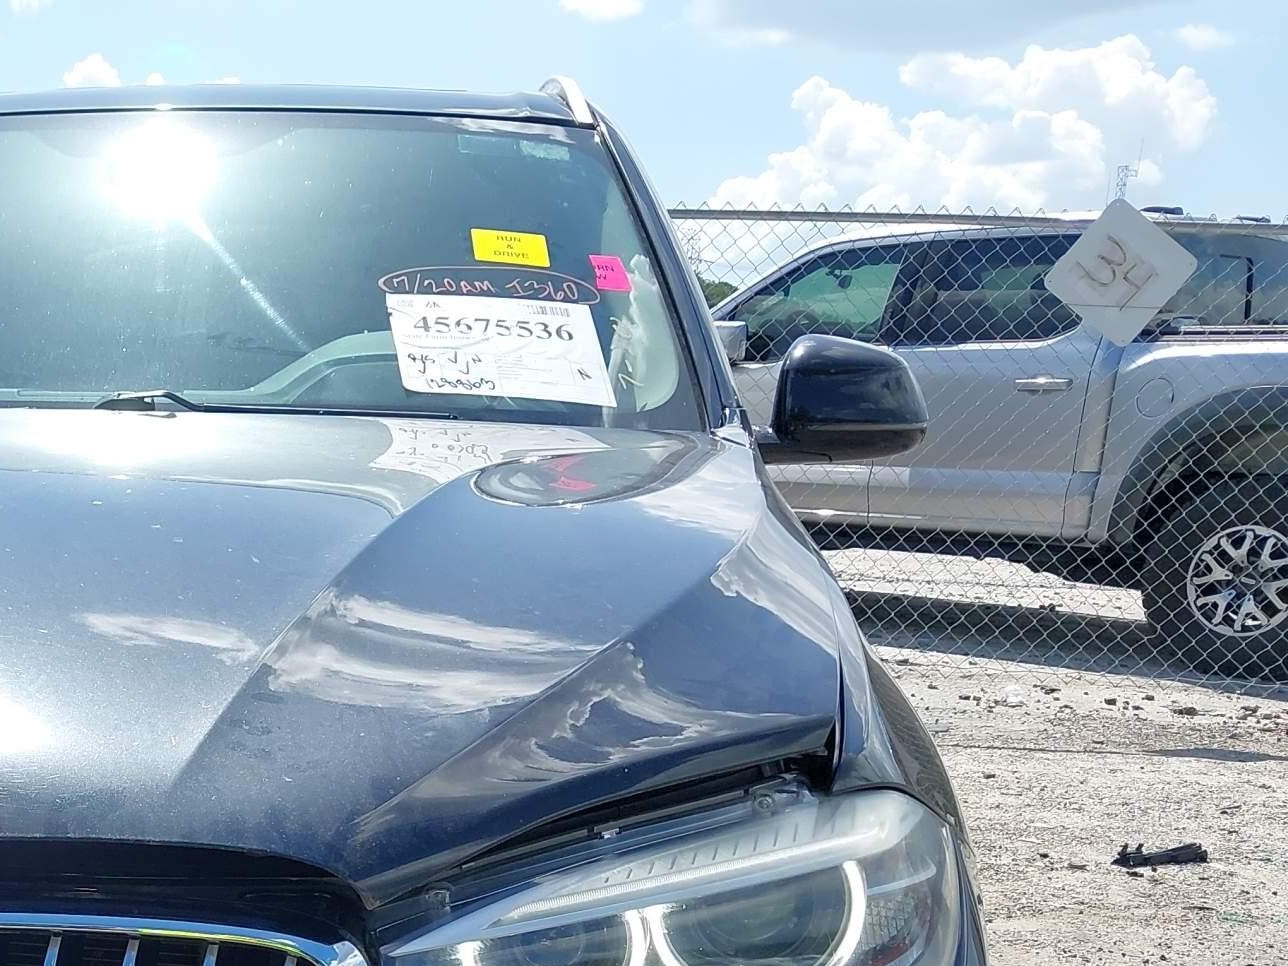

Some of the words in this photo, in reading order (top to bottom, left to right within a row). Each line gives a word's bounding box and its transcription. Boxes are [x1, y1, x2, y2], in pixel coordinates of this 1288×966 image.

[496, 234, 521, 243] RUN
[493, 250, 530, 259] DRIVE
[413, 315, 575, 342] 45675536
